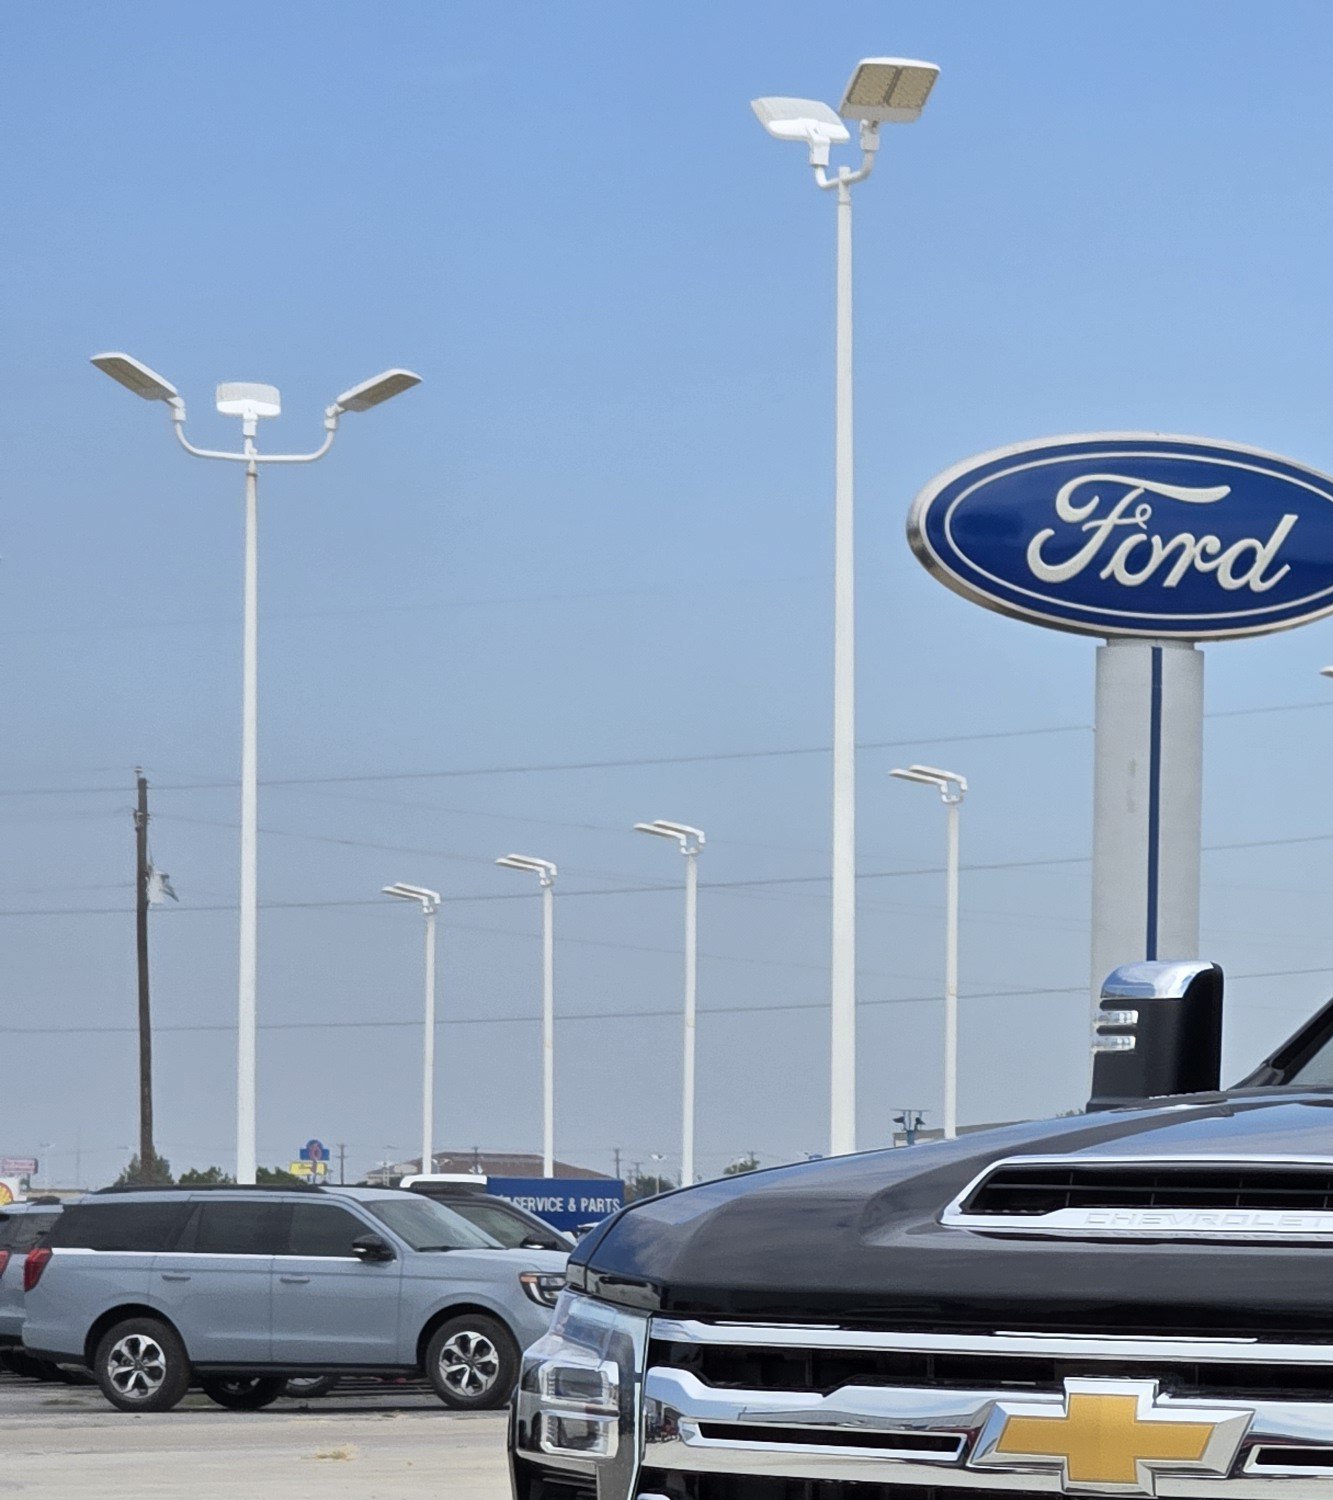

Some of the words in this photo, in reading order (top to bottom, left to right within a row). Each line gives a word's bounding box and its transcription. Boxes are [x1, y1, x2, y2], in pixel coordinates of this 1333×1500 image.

[1027, 474, 1298, 592] Ford
[512, 1196, 564, 1212] SERVICE
[568, 1197, 576, 1212] &
[581, 1197, 621, 1213] PARTS
